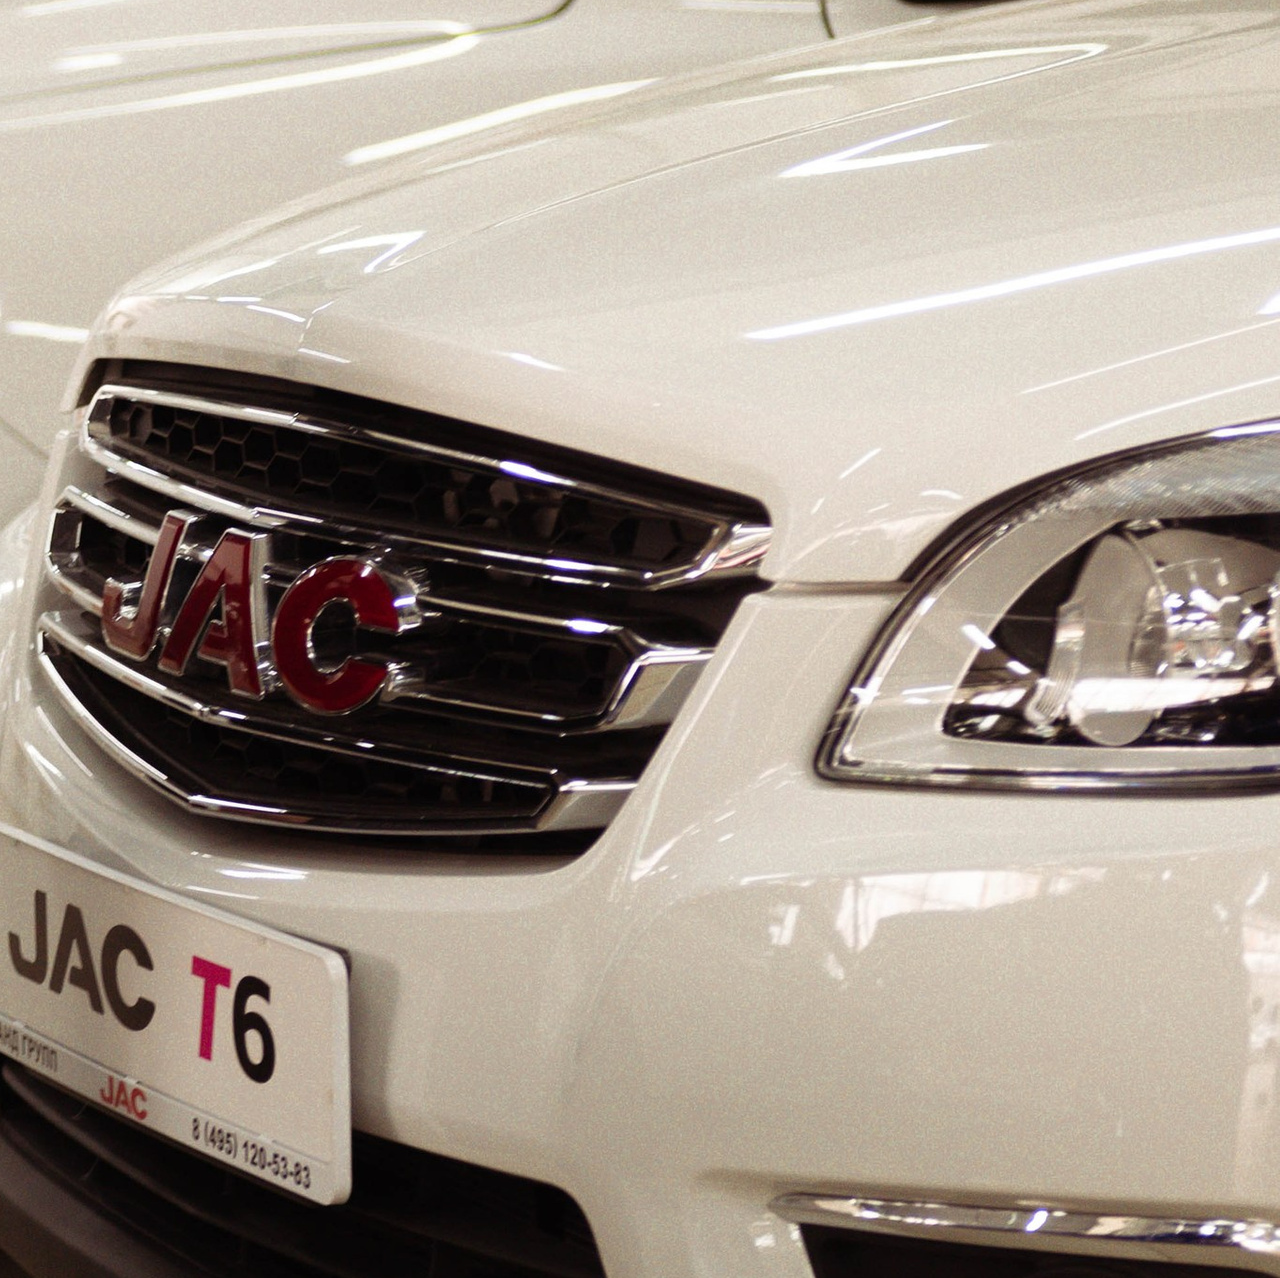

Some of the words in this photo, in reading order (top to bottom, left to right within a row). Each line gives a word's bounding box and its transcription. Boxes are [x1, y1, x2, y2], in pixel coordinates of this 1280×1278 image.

[102, 509, 418, 715] JAC
[8, 889, 156, 1032] JAC
[191, 955, 276, 1084] T6
[22, 1034, 58, 1073] ГРУПП
[99, 1075, 148, 1120] JAC
[192, 1118, 200, 1141] 8
[204, 1121, 238, 1159] (495)
[243, 1140, 311, 1189] 120-53-83
